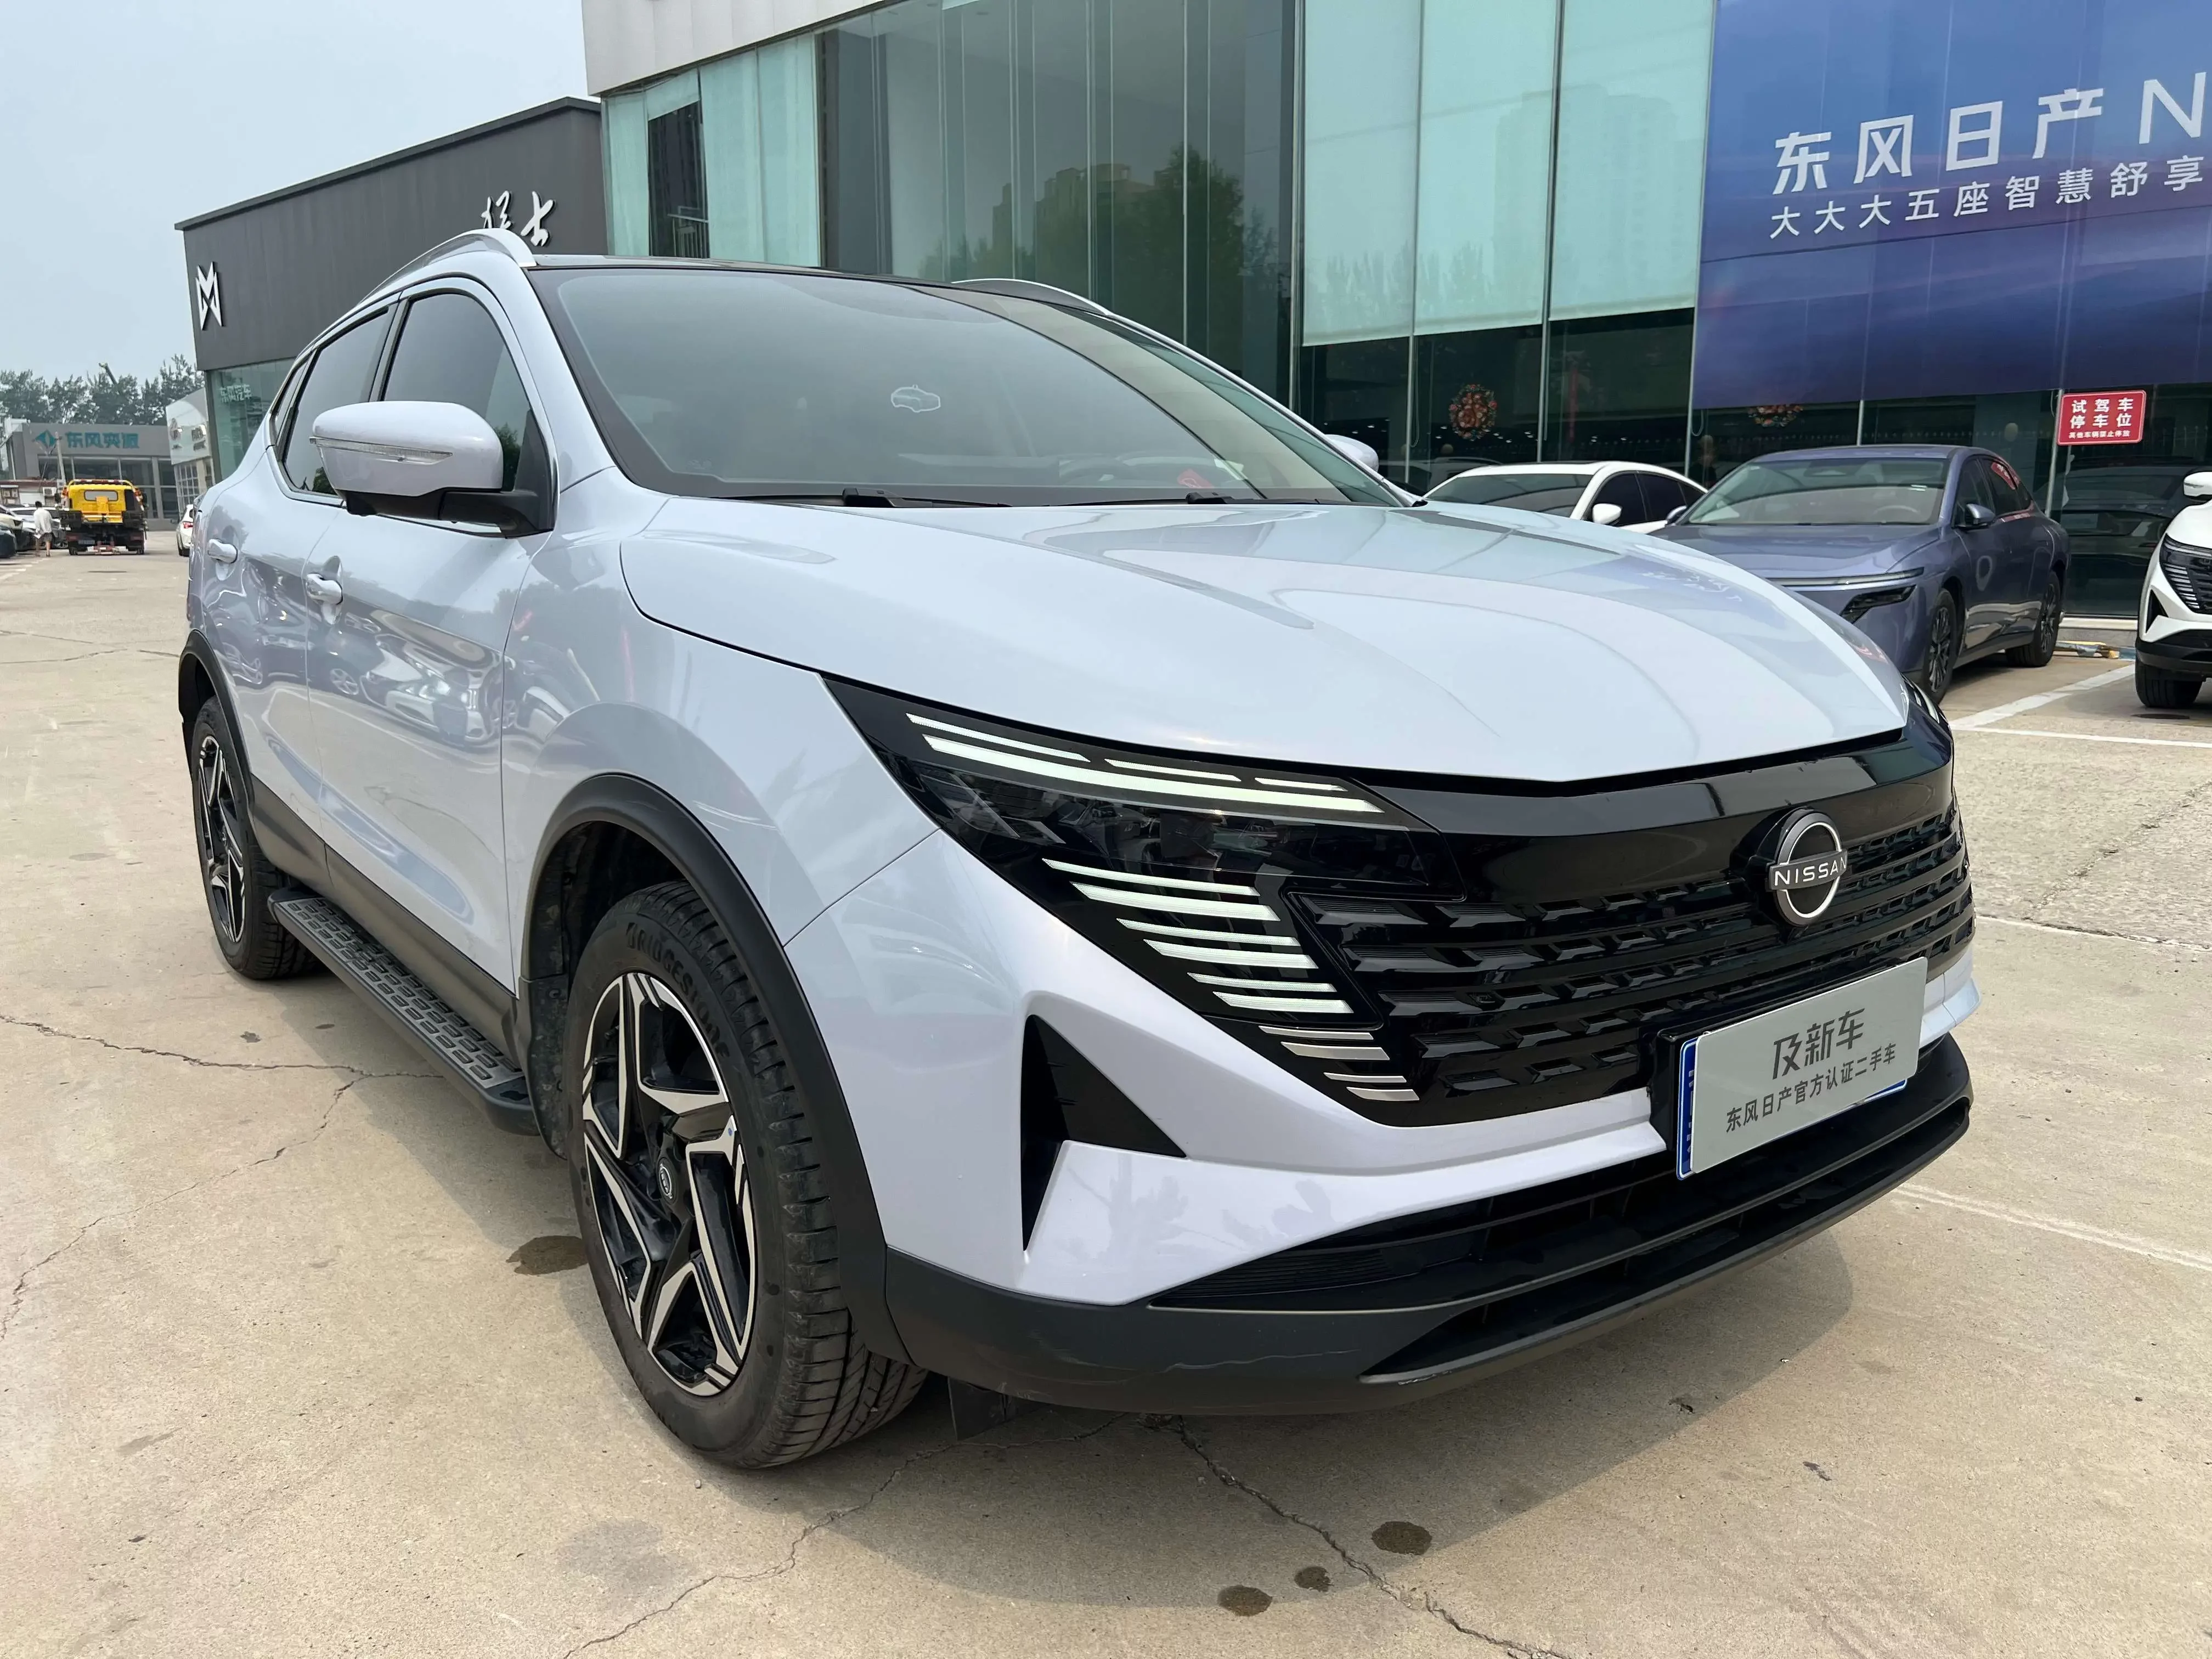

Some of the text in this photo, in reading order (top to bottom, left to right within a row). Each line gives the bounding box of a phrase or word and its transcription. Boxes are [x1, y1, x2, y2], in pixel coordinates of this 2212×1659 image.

[1770, 155, 2203, 239] 大大大五座智慧舒享
[2070, 413, 2132, 429] 停车位
[2072, 397, 2134, 414] 试驾车
[1774, 857, 1847, 886] NISSAN
[626, 922, 731, 1058] BRIDGESTONE
[1773, 1007, 1865, 1080] 及新车
[1726, 1042, 1897, 1133] 东风日产官方认证二手车
